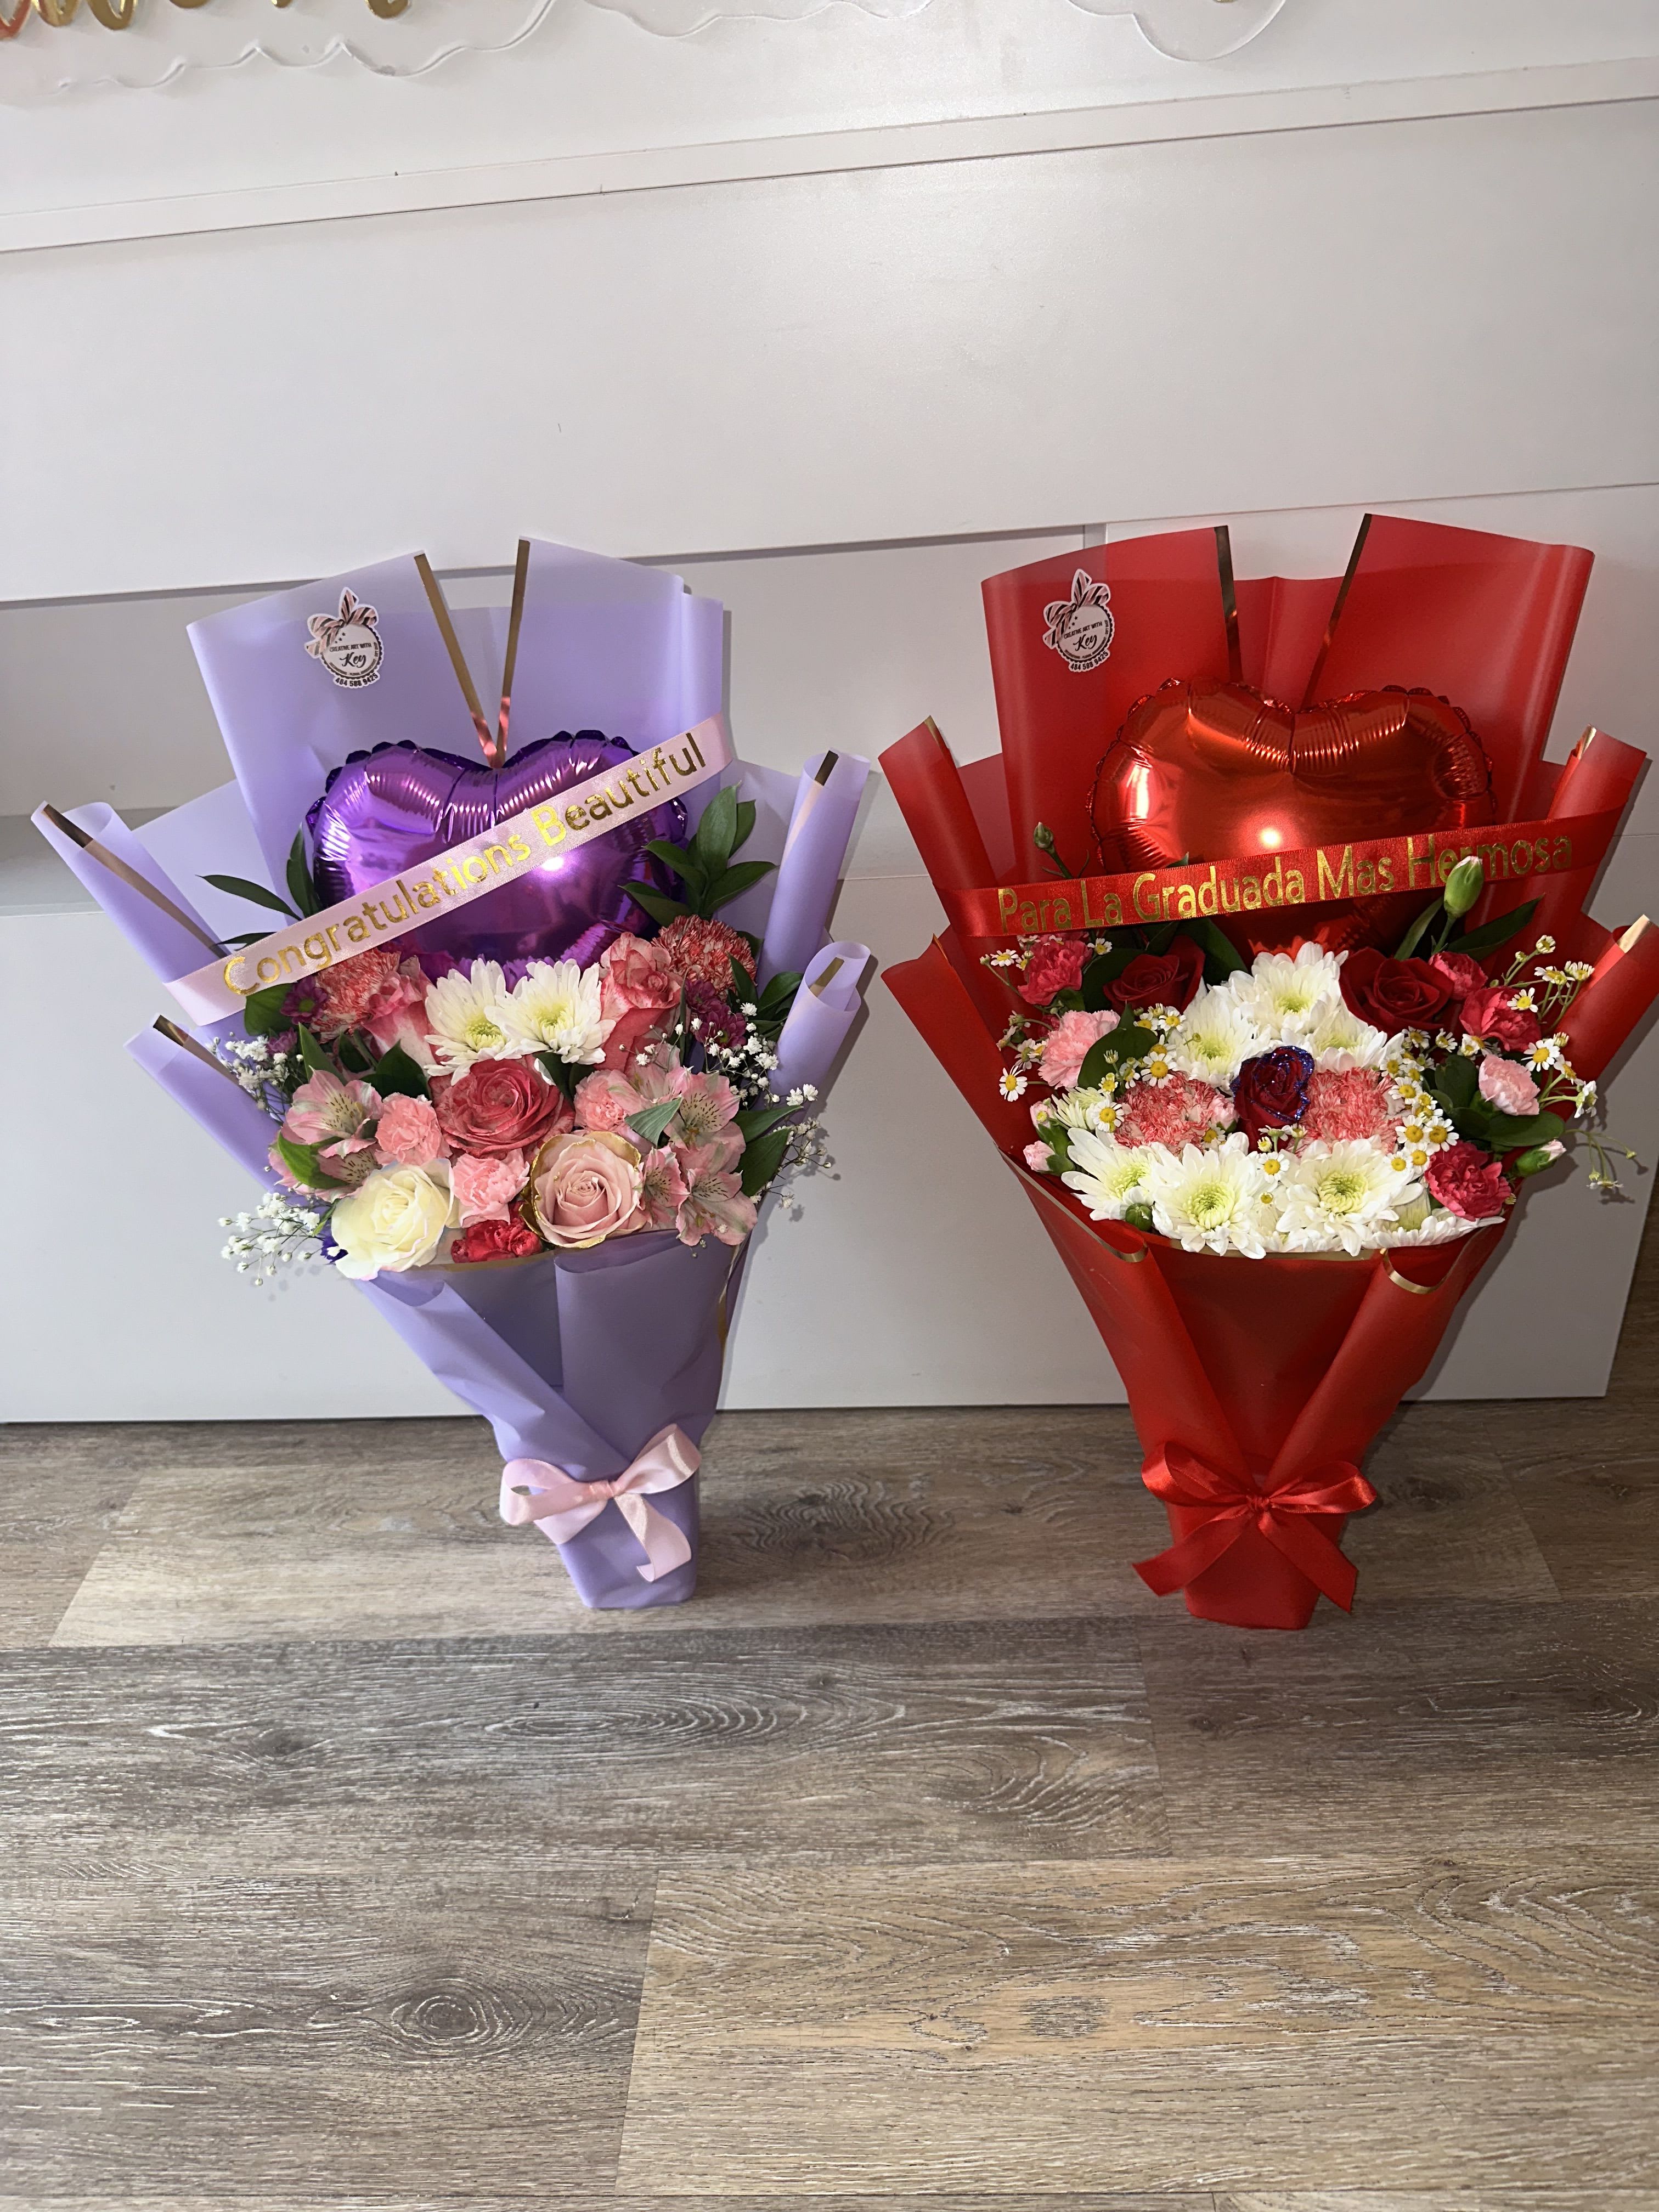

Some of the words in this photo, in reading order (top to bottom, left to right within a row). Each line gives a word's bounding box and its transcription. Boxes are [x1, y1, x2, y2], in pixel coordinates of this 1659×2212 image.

[1091, 621, 1102, 629] WITH
[1073, 634, 1097, 651] Key
[339, 652, 366, 668] Key
[1094, 651, 1108, 665] 9425
[363, 673, 379, 685] 9425
[223, 833, 532, 996] Congratulations
[531, 732, 706, 847] Beautiful
[997, 888, 1072, 934] Para
[1080, 880, 1123, 928] La
[1133, 856, 1306, 922] Graduada
[1316, 845, 1395, 900] Mas
